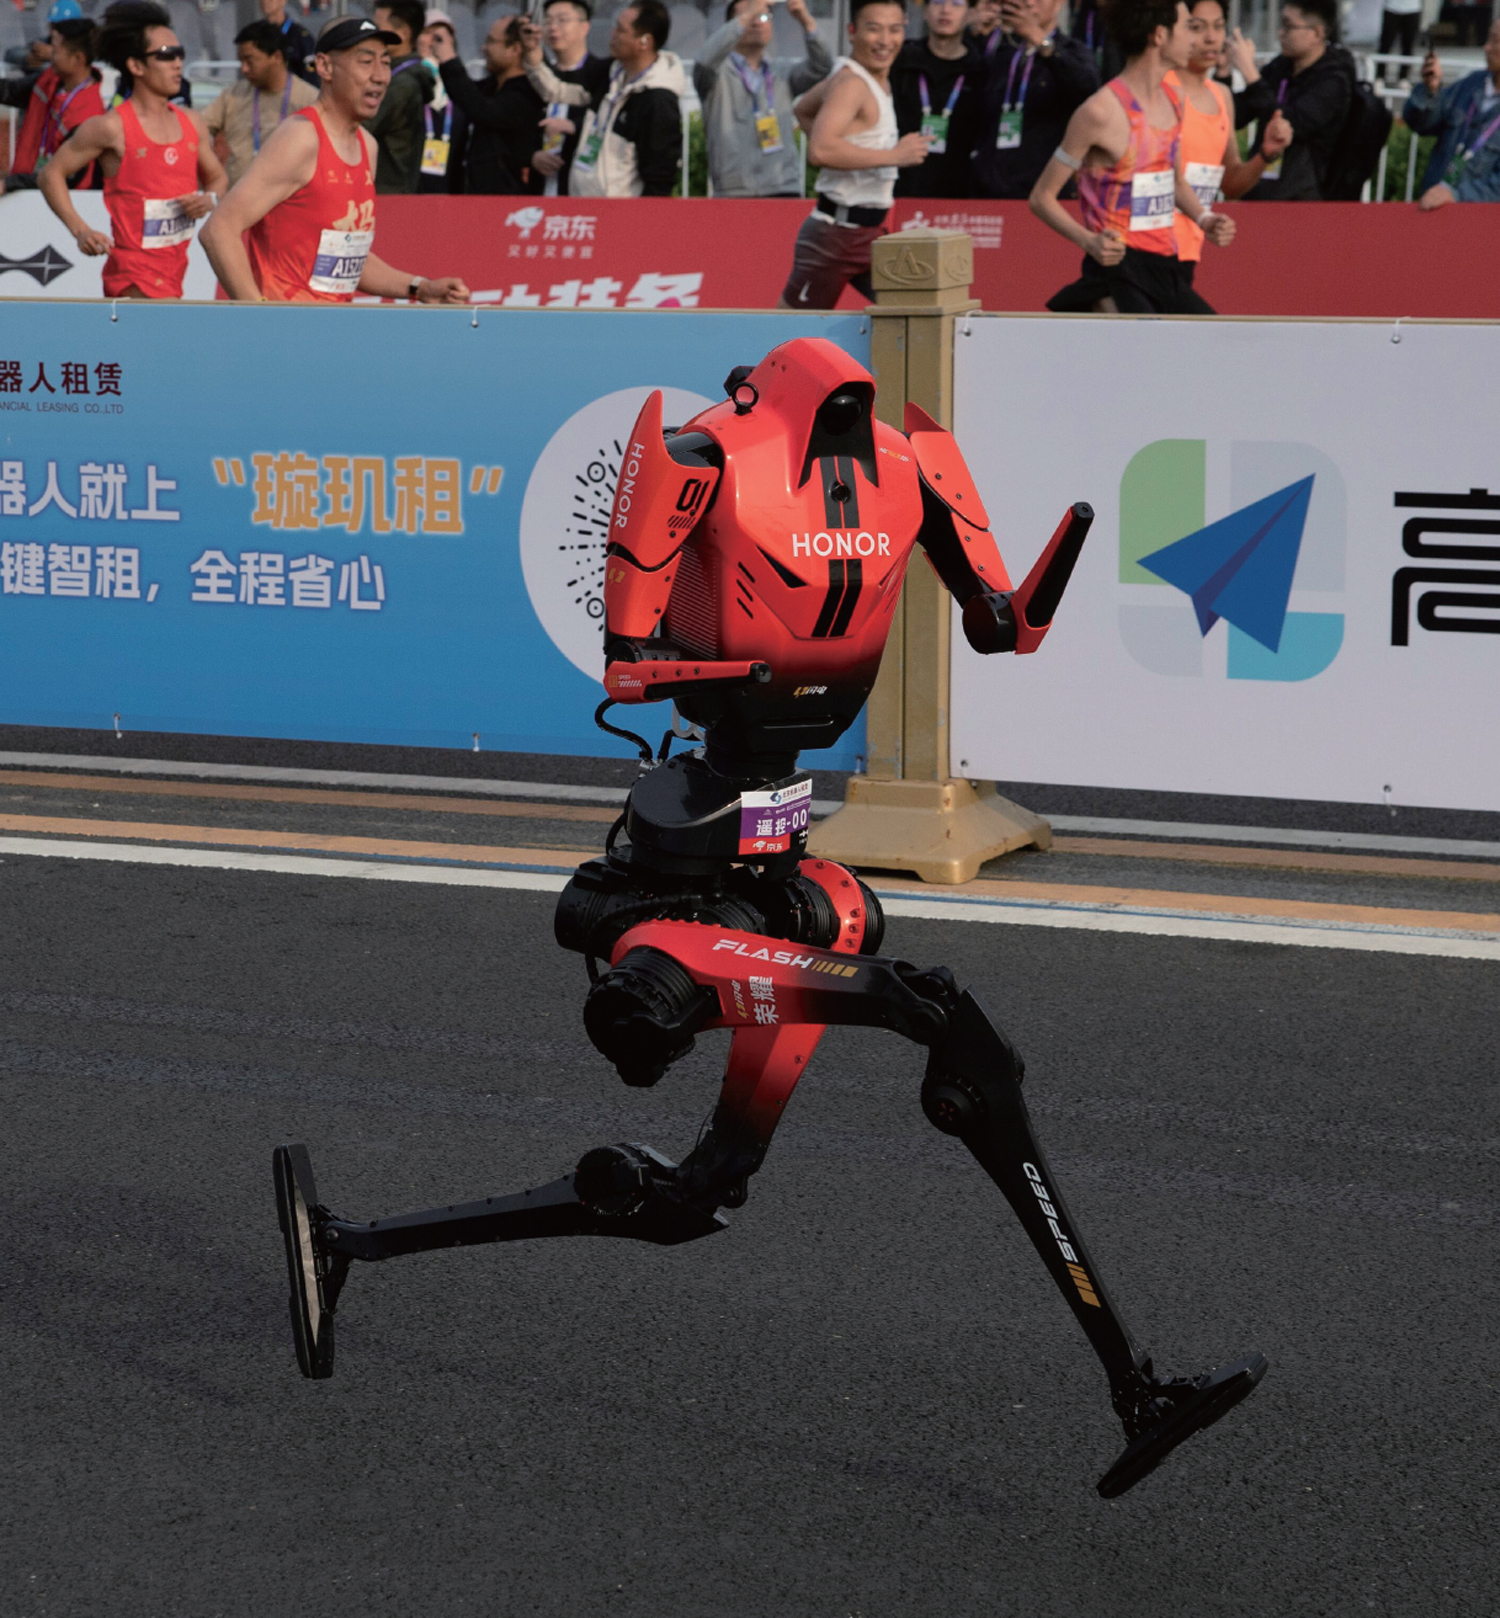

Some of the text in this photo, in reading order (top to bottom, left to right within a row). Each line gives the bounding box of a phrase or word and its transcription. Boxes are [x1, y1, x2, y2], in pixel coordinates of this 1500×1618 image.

[543, 215, 597, 240] 京东
[0, 360, 122, 396] 器人租赁
[37, 402, 79, 413] LEASING
[615, 442, 645, 528] HONOR
[792, 532, 891, 557] HONOR
[756, 808, 811, 836] 遥控-00
[712, 939, 814, 969] FLASH
[749, 975, 779, 1025] 荣耀
[1022, 1162, 1079, 1263] SPEED
